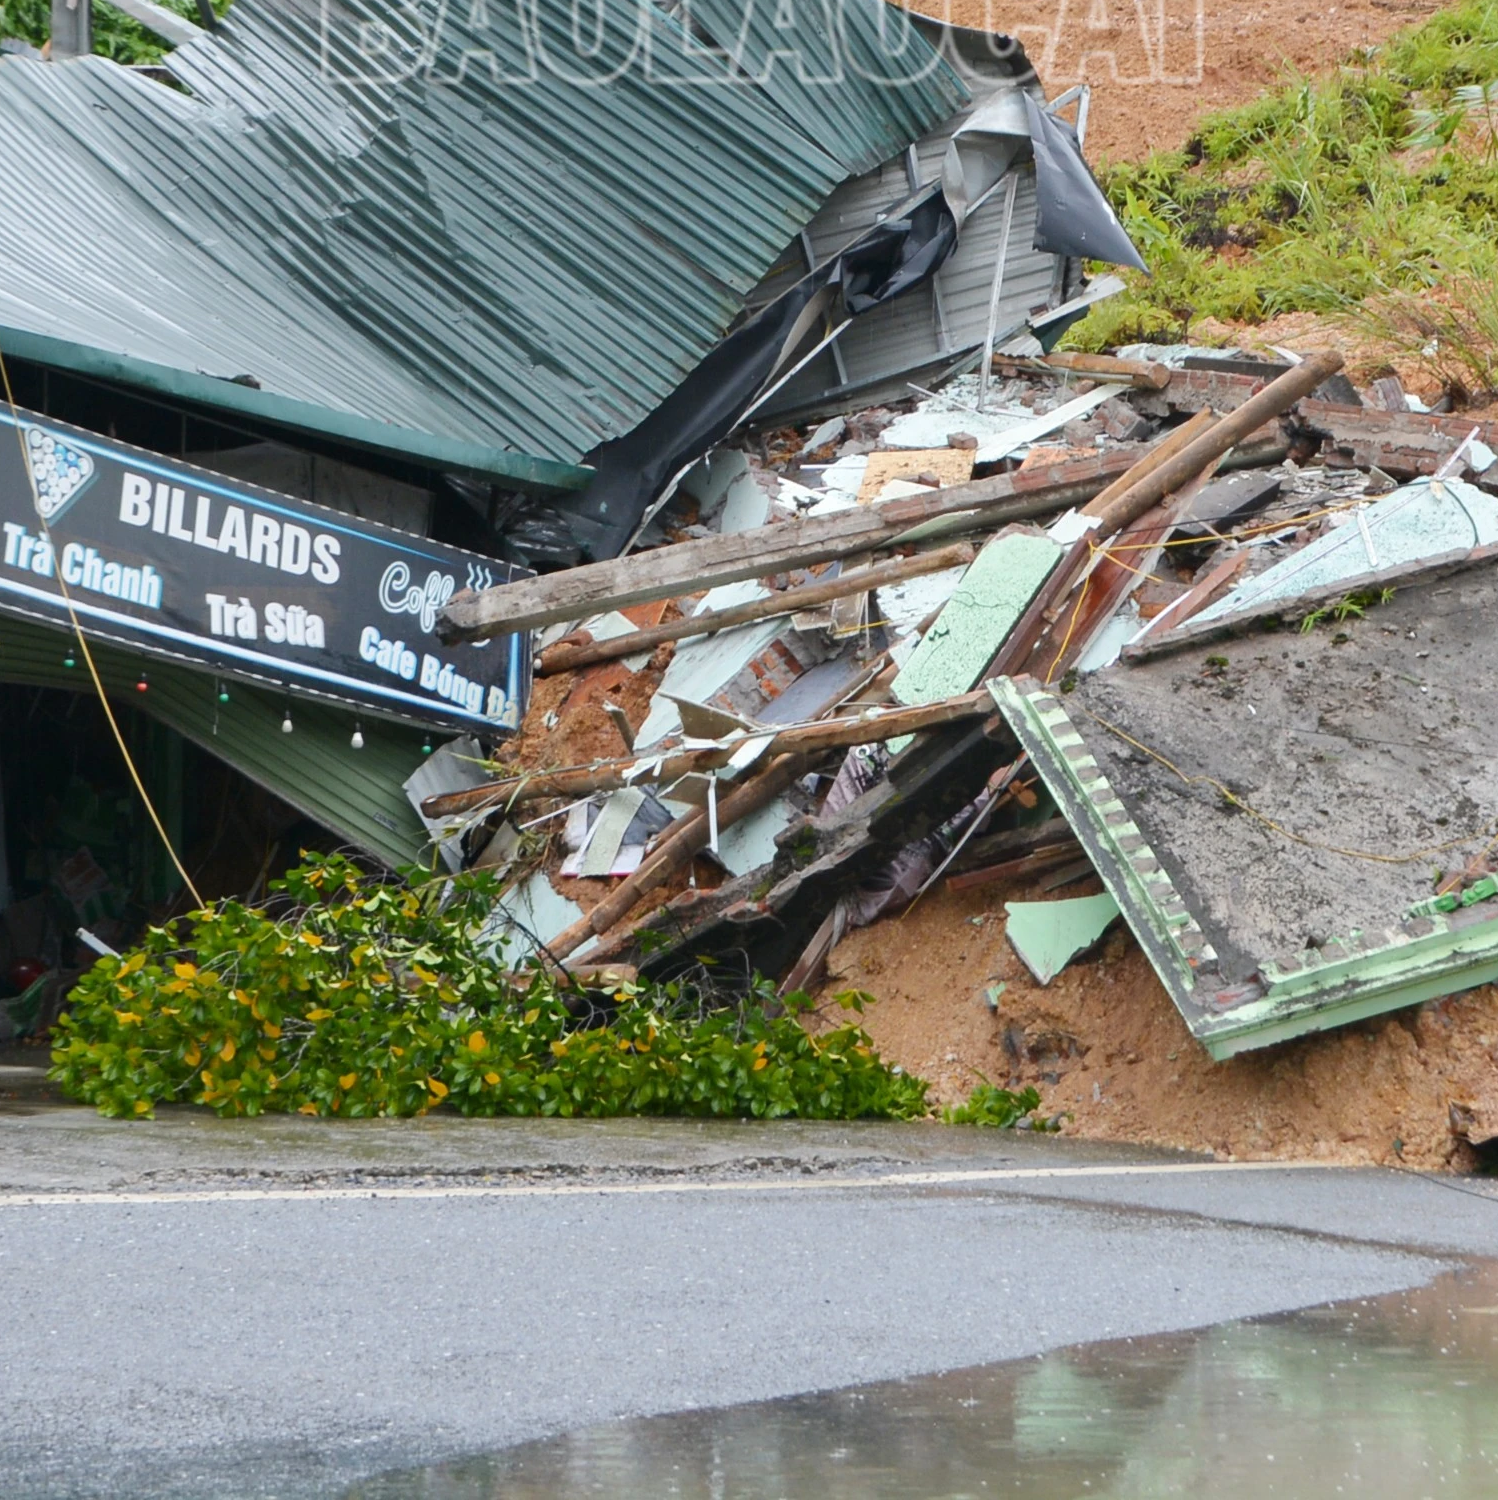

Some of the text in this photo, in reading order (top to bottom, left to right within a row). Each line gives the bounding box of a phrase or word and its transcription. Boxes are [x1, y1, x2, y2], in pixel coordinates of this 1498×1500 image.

[3, 521, 162, 610] Trà Chanh
[119, 472, 342, 585] BILLARDS
[205, 592, 326, 649] Trà Sữa
[379, 560, 456, 633] Coff
[359, 625, 418, 681] Cafe
[419, 653, 484, 714] Bóng
